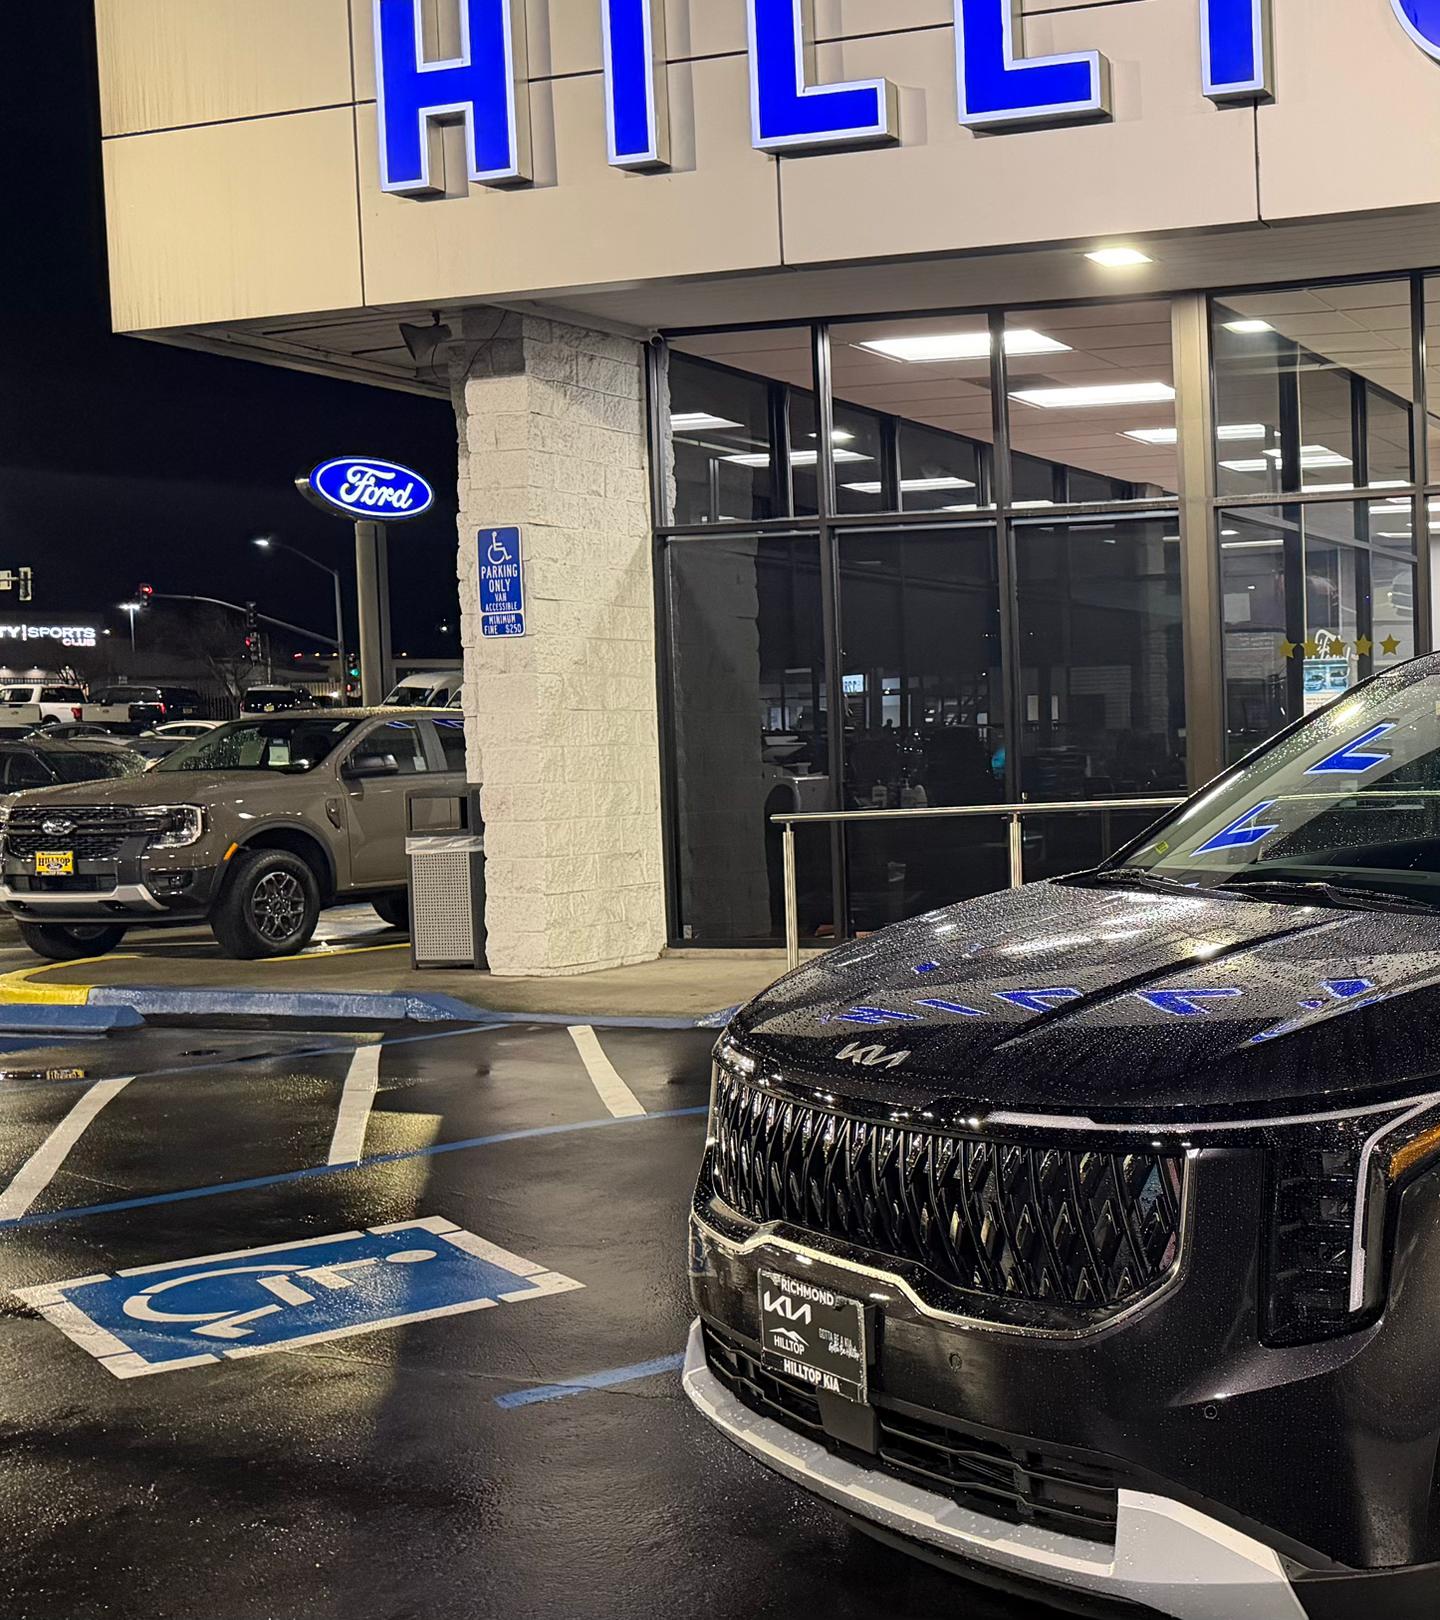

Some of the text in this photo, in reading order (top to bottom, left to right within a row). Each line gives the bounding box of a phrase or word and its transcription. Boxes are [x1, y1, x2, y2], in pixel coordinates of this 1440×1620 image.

[340, 466, 413, 508] Ford
[481, 564, 518, 579] PARKING
[489, 579, 511, 593] ONLY
[495, 592, 507, 602] VAN
[485, 601, 518, 611] ACCESSIBLE
[489, 614, 516, 624] MINIMUM
[28, 626, 96, 638] SPORTS
[484, 624, 522, 635] FINE $250
[62, 638, 96, 646] CLUB
[38, 857, 71, 867] HILLTOP
[781, 1278, 834, 1306] RICHMOND
[773, 1334, 805, 1355] HILLTOP
[783, 1358, 840, 1392] HILLTOP KIA
